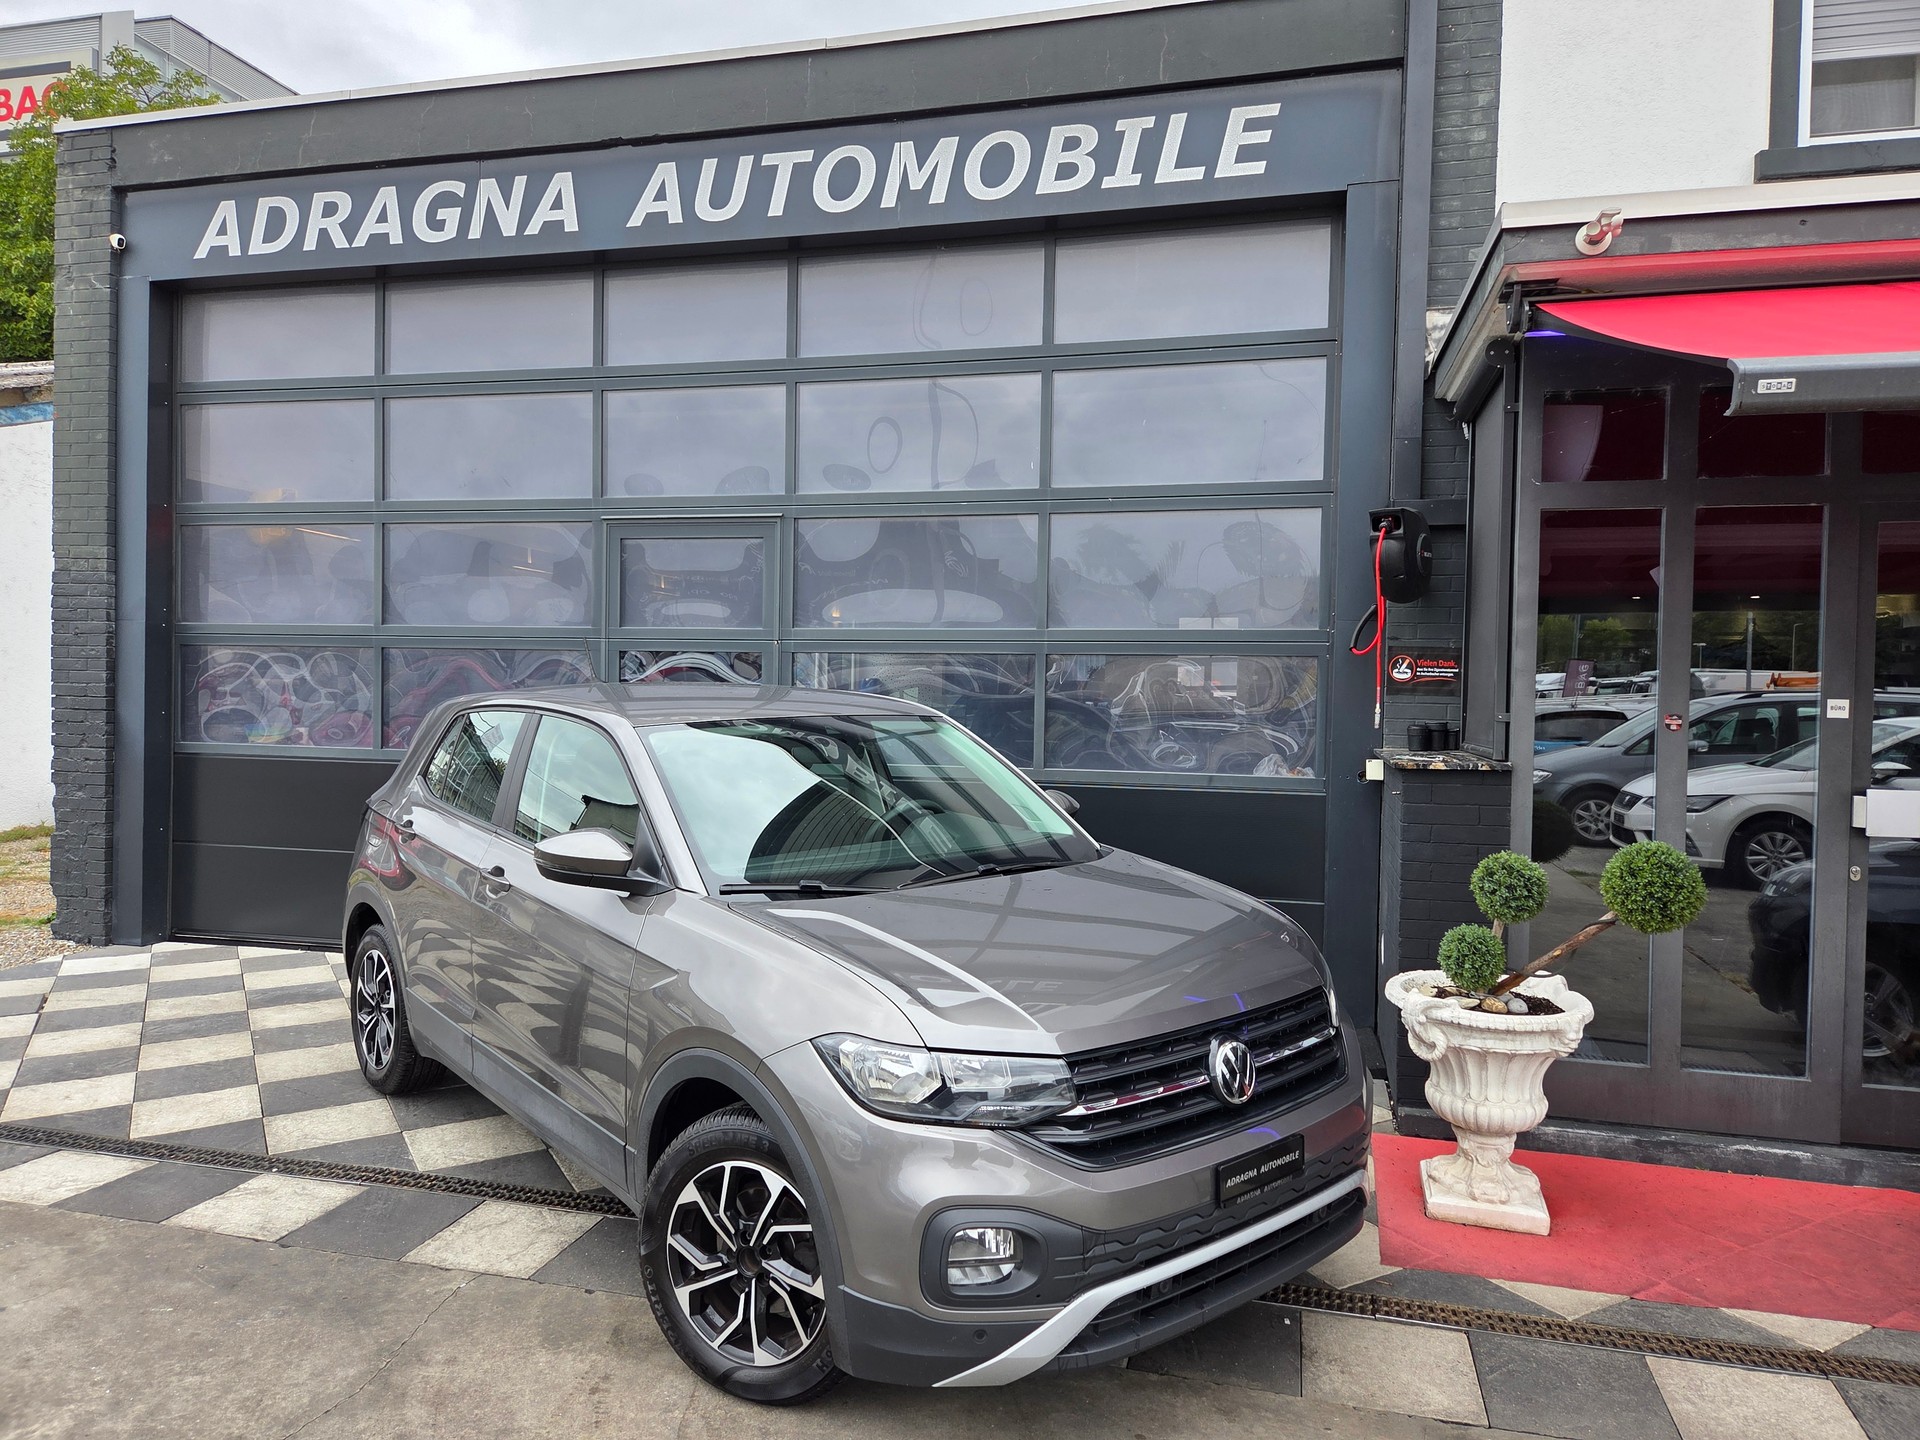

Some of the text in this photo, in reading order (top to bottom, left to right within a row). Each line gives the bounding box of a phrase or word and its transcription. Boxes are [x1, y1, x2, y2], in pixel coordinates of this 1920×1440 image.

[193, 103, 1282, 260] ADRAGNA AUTOMOBILE
[1417, 659, 1438, 667] Vielen
[1829, 704, 1847, 712] BÜRO
[1226, 1150, 1300, 1188] ADRAGNA AUTOMOBILE
